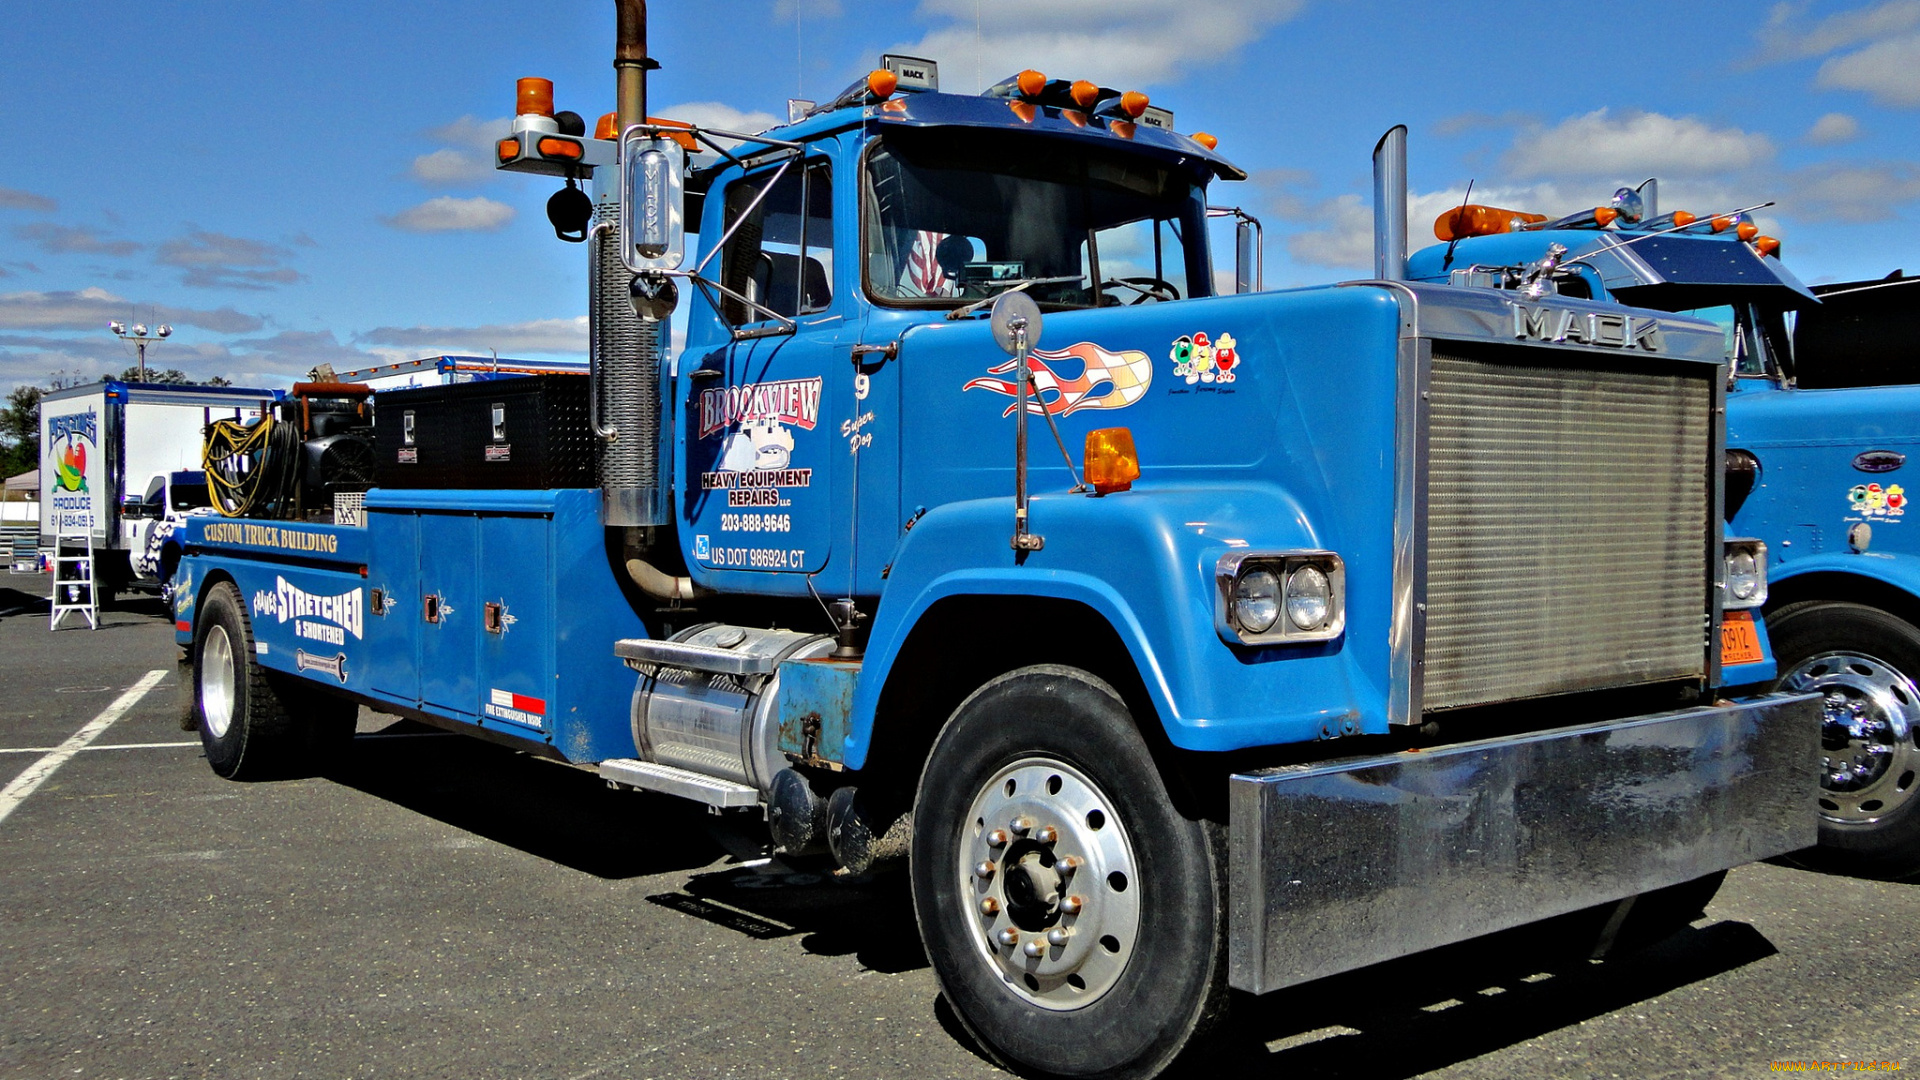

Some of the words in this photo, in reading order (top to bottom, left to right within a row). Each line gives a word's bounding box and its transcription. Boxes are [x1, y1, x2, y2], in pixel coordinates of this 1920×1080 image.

[903, 69, 924, 79] MACK
[1144, 116, 1162, 127] MACK
[1513, 303, 1658, 351] MACK
[855, 373, 870, 400] 9
[699, 376, 822, 440] BROOKVIEW
[841, 411, 875, 438] Super
[850, 433, 872, 453] Dog
[702, 471, 737, 488] HEAVY
[738, 469, 812, 487] EQUIPMENT
[53, 496, 91, 510] PRODUCE
[729, 490, 779, 506] REPAIRS
[721, 514, 791, 532] 203-888-9646
[204, 523, 243, 543] CUSTOM
[244, 525, 279, 547] TRUCK
[280, 531, 338, 553] BUILDING
[711, 548, 727, 565] US
[728, 548, 748, 565] DOT
[750, 549, 788, 567] 986924
[790, 550, 804, 568] CT
[277, 575, 364, 640] STRETCHED
[302, 621, 345, 646] SHORTENED
